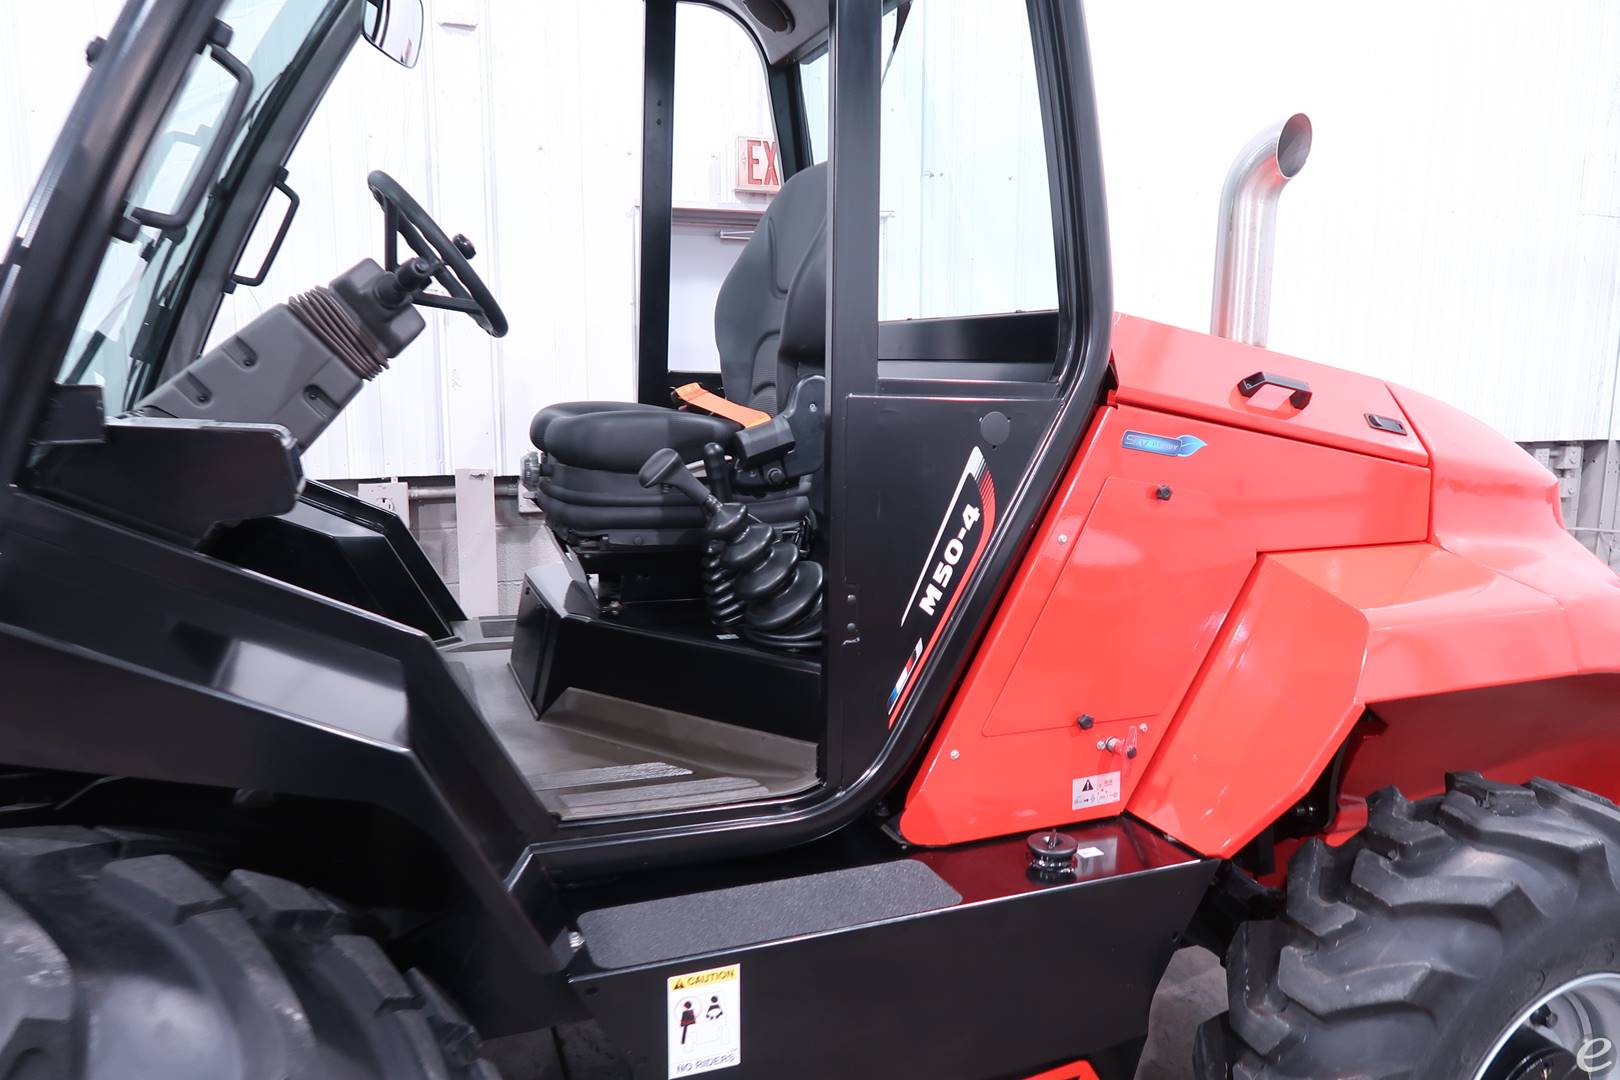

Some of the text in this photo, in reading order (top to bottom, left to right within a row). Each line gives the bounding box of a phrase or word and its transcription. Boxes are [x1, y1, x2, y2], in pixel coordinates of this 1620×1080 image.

[686, 969, 735, 986] CAUTION
[676, 1053, 736, 1074] NO RIDERS
